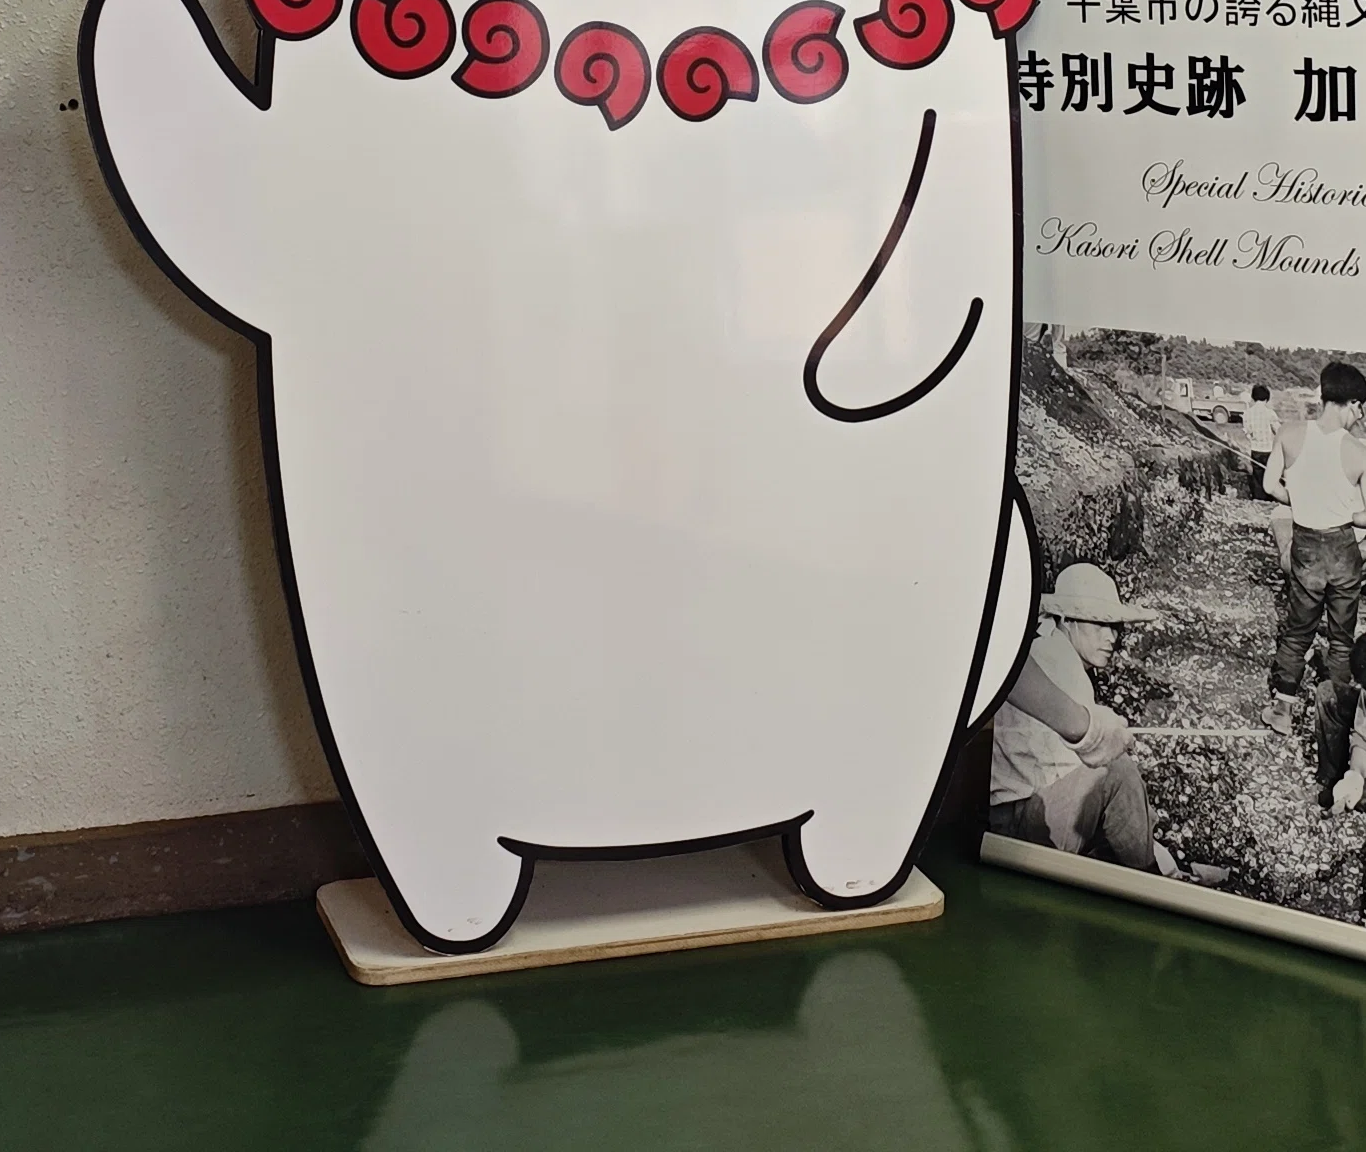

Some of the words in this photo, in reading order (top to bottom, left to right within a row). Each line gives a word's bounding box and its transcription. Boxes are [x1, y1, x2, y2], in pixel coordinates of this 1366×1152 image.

[1018, 49, 1246, 118] 特別史跡
[1142, 159, 1249, 209] Special
[1035, 217, 1139, 260] Kasori
[1149, 228, 1228, 270] Shell
[1232, 230, 1361, 278] Mounds
